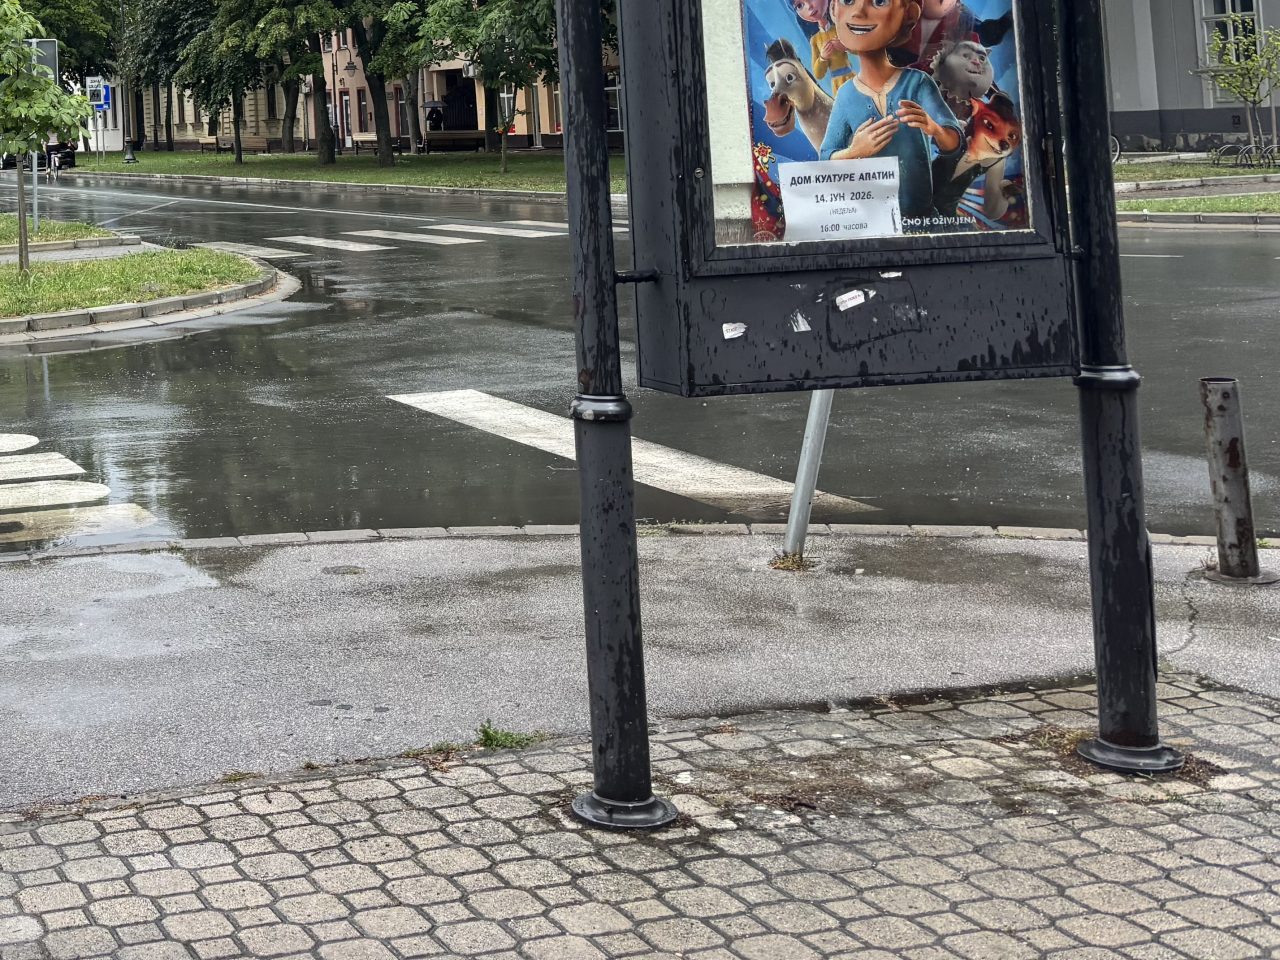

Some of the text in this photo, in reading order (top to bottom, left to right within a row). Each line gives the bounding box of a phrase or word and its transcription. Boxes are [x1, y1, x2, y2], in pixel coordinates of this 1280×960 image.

[790, 171, 895, 187] ДОМ КУЛТУРЕ АПАТИН
[815, 191, 874, 203] 14. ЈУН 2026.
[901, 215, 977, 226] ČNO JE OŽIVLJENA
[820, 222, 868, 233] 16:00 часова
